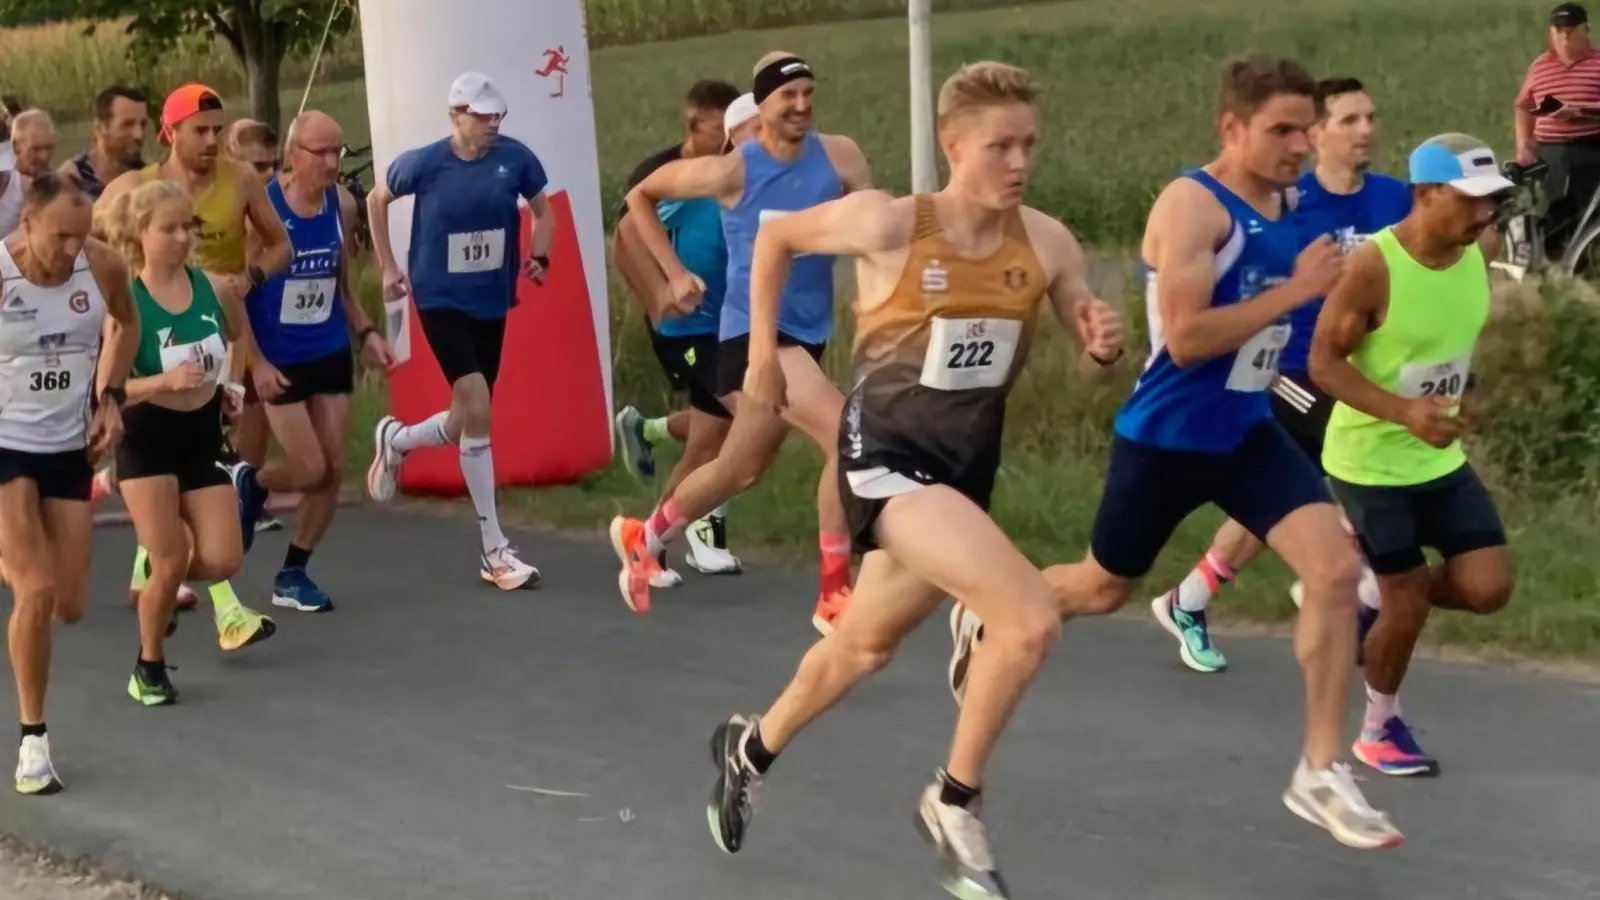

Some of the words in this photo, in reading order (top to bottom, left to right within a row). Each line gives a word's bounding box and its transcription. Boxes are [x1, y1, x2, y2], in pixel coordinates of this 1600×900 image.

[295, 292, 325, 310] 374
[947, 341, 994, 369] 222
[30, 371, 71, 391] 368
[1420, 373, 1460, 396] 240
